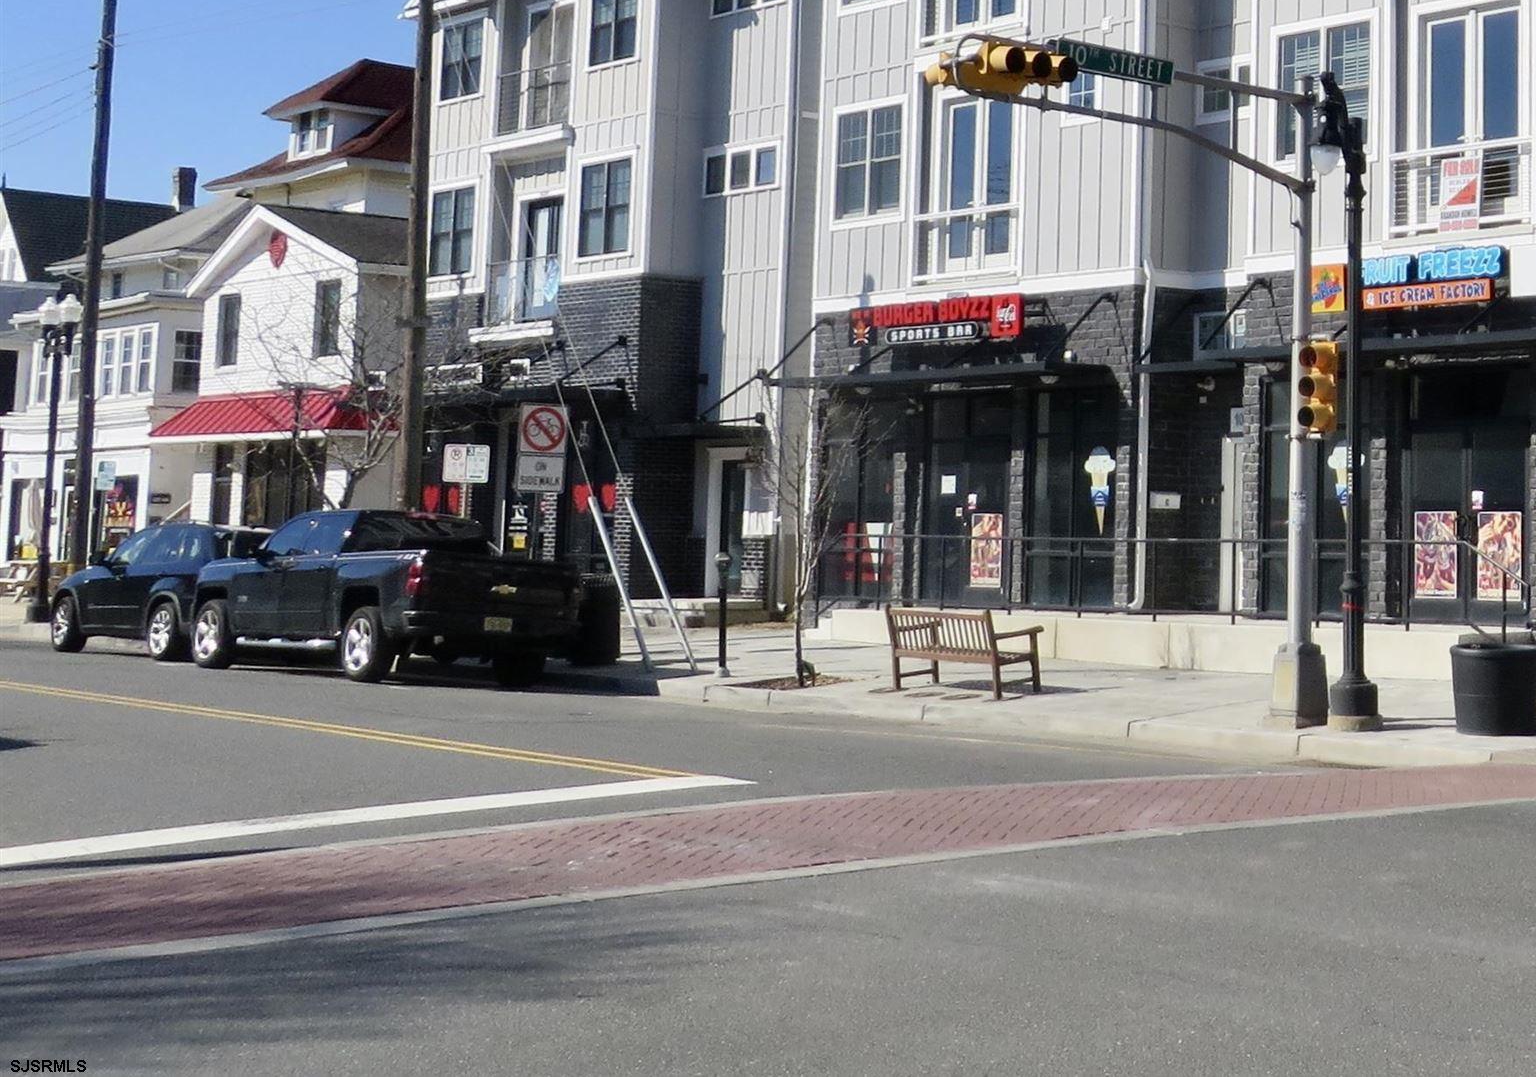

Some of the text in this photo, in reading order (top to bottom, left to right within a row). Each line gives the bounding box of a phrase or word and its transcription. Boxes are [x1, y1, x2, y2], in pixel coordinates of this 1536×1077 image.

[1108, 52, 1164, 80] STREET
[1362, 245, 1501, 286] RUIT FREEZZ
[1379, 289, 1395, 305] ICE
[1400, 286, 1435, 301] CREAM
[1440, 282, 1486, 299] FACTORY
[873, 301, 934, 326] BURGER
[938, 295, 992, 322] BOYZZ
[891, 324, 973, 341] SPORTS BAR
[535, 461, 548, 471] ON
[519, 475, 561, 486] SIDEWALK
